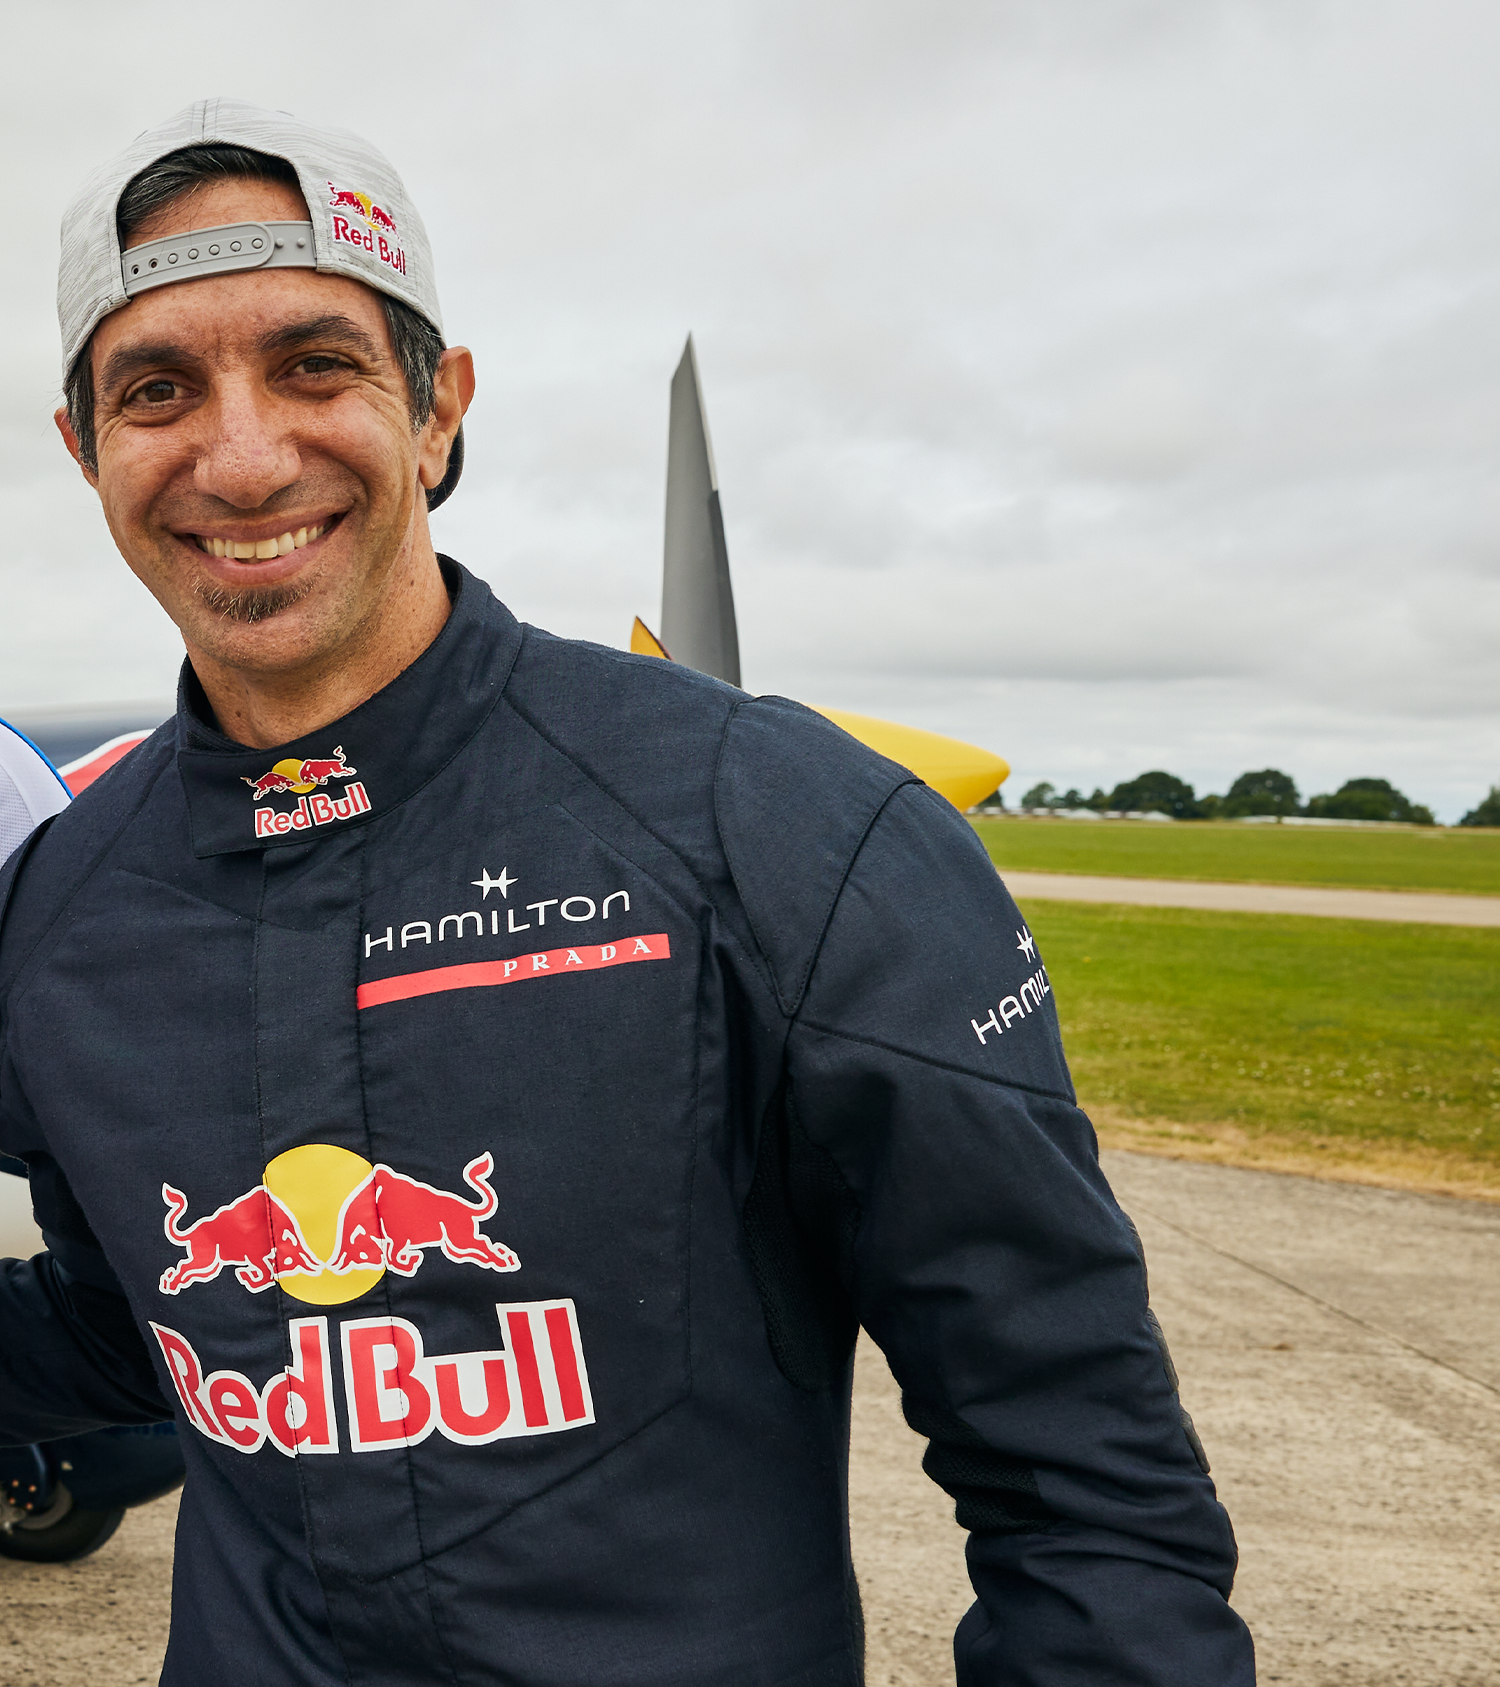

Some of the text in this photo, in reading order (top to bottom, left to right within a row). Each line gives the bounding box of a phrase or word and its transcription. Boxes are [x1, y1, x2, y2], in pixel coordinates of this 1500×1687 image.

[332, 215, 407, 277] Red Bull
[256, 782, 371, 836] Red Bull
[364, 889, 631, 959] HAMILTON
[502, 937, 653, 978] PRADA
[970, 964, 1050, 1046] HAMIL
[153, 1304, 590, 1453] Red Bull
